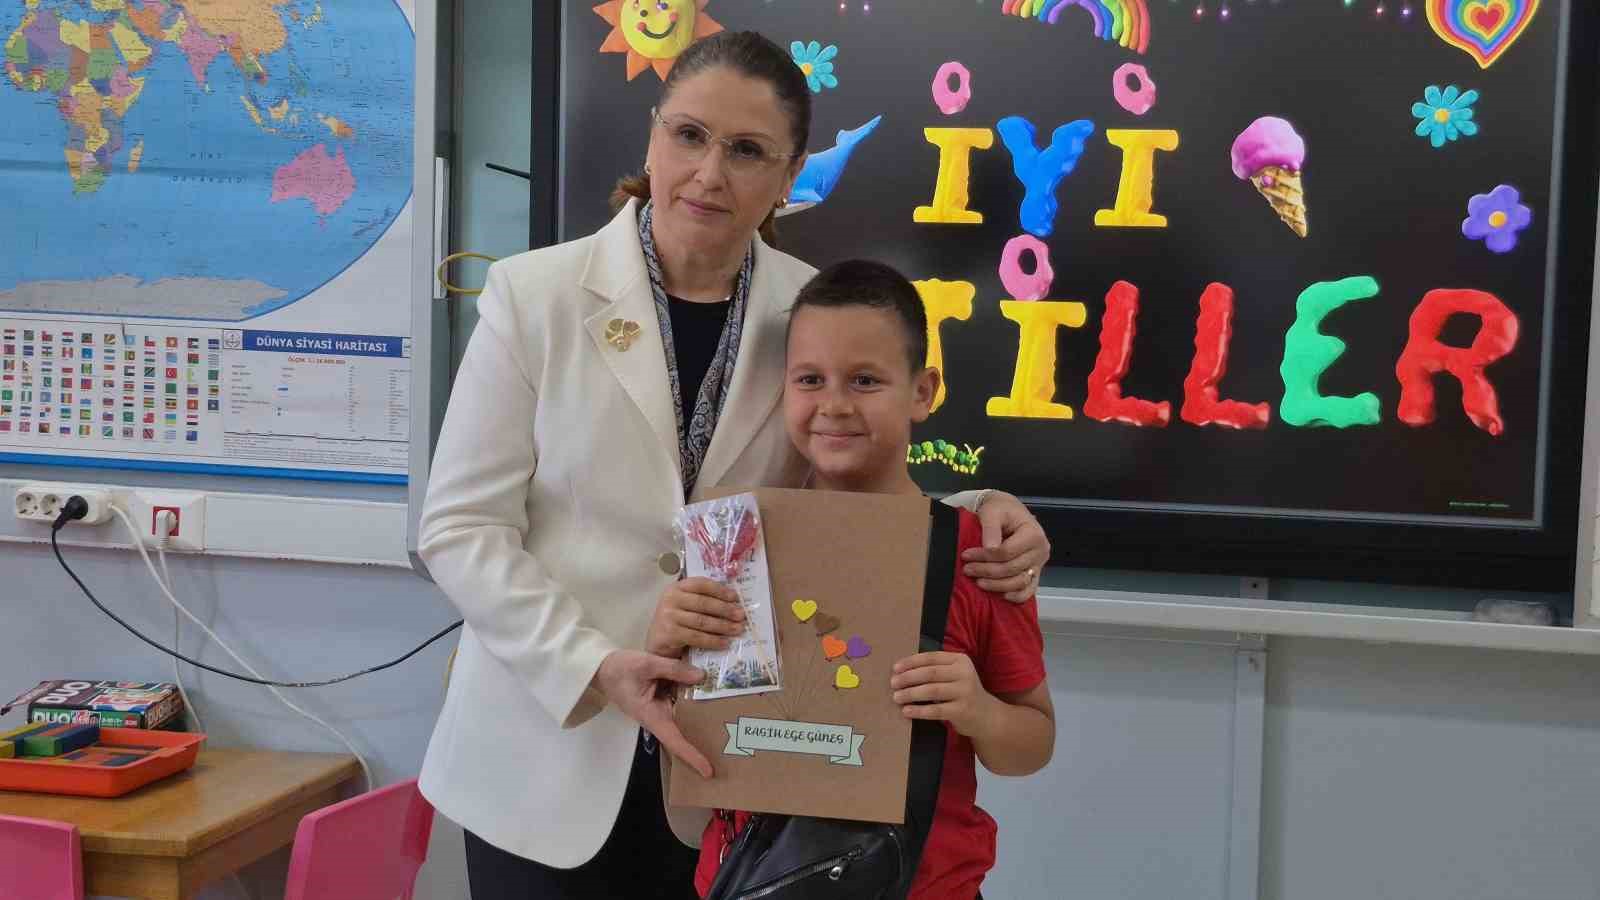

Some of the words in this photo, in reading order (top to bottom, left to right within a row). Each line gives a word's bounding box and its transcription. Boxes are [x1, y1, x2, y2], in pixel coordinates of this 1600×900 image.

[256, 335, 294, 348] DÜNYA
[295, 337, 332, 350] SİYASİ
[335, 341, 388, 353] HARİTASI
[34, 681, 91, 704] DUO
[33, 711, 71, 724] DUO
[783, 728, 805, 742] EGE
